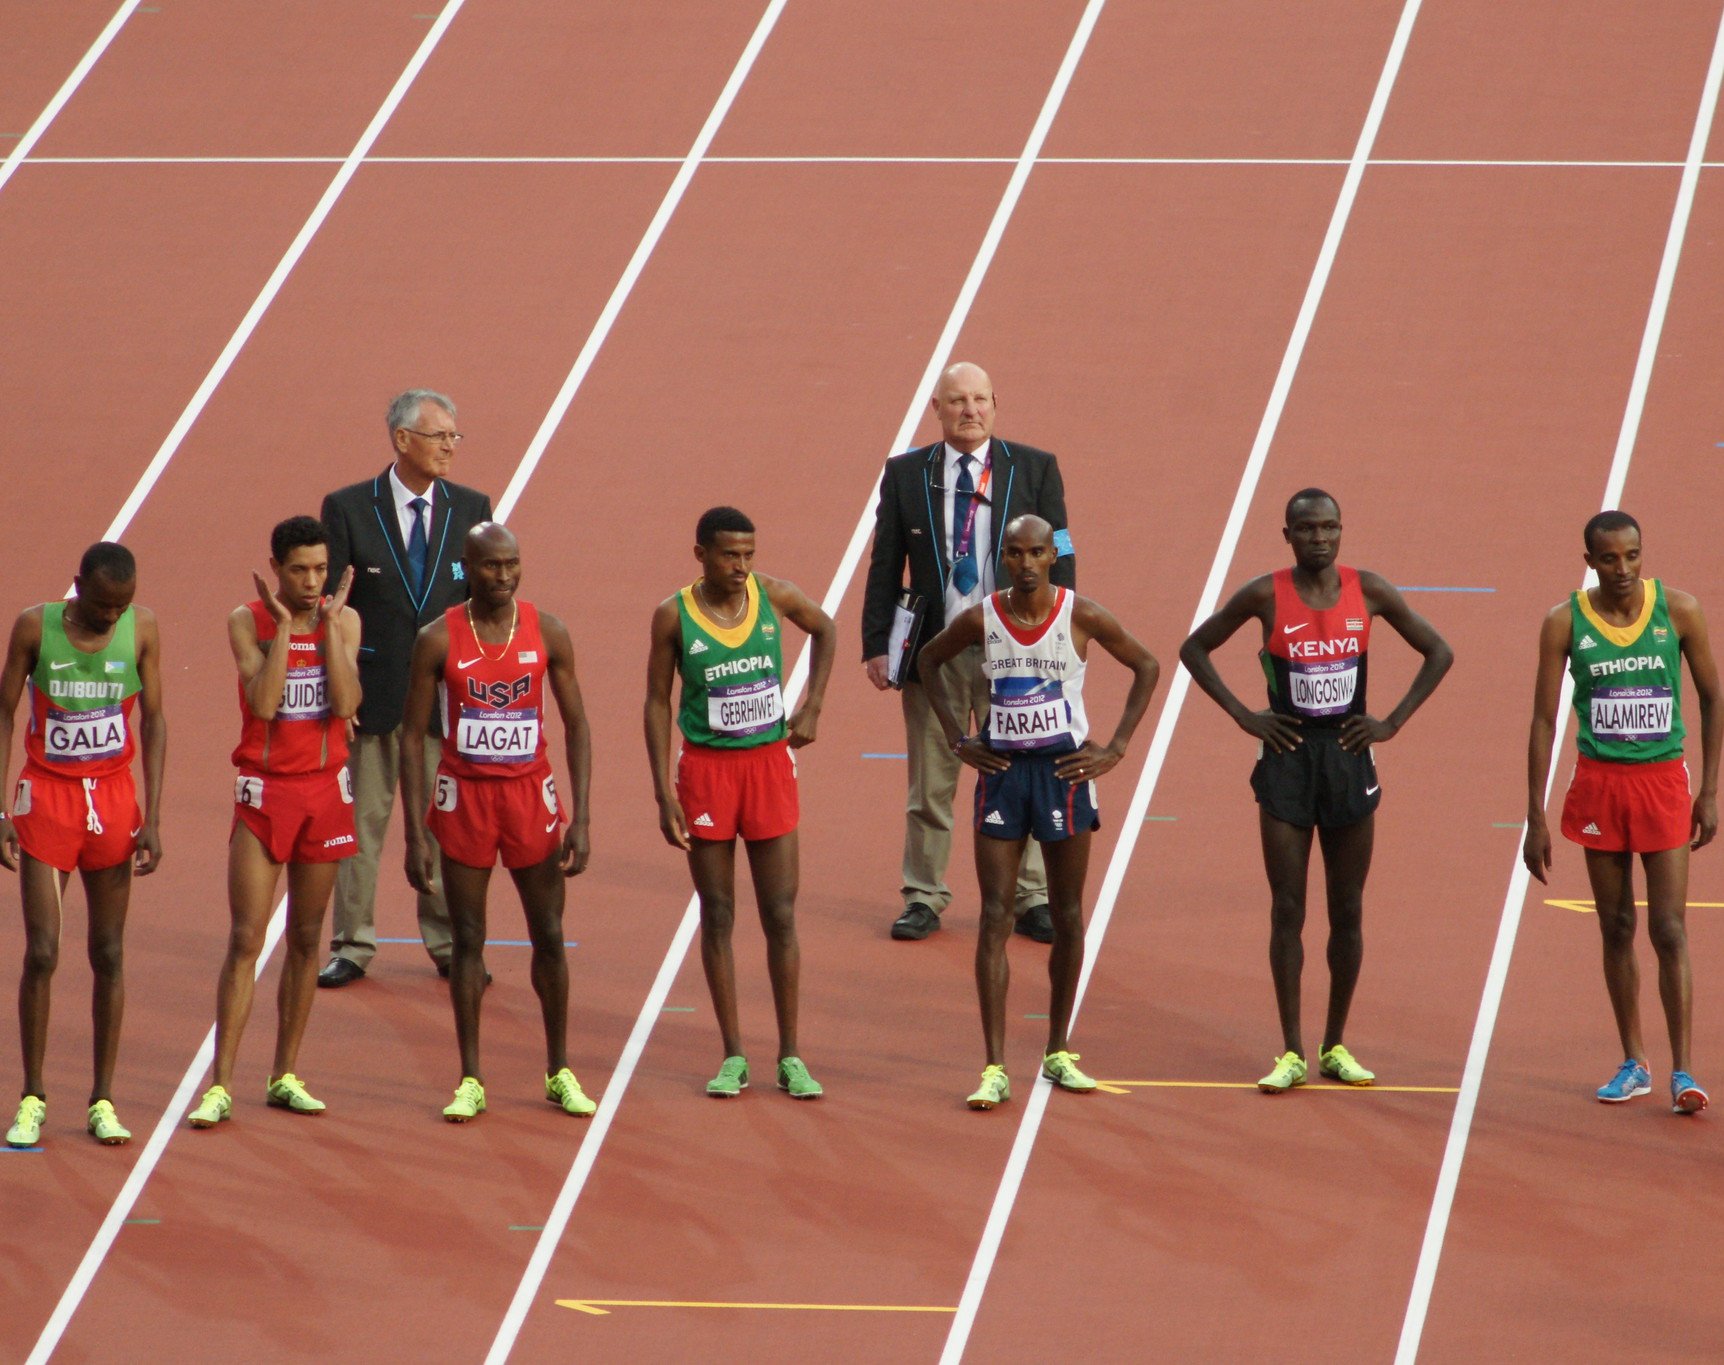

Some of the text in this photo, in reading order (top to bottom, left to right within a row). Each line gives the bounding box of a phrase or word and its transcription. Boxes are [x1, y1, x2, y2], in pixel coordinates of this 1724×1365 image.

[1288, 637, 1359, 658] KENYA
[287, 669, 306, 677] ndon
[704, 655, 774, 681] ETHIOPIA
[991, 657, 1067, 671] GREAT BRITAIN
[1304, 662, 1345, 673] London 2012
[1589, 655, 1665, 677] ETHIOPIA
[50, 680, 124, 699] DJIBOUTI
[467, 672, 532, 710] USA
[726, 681, 768, 696] London 2012
[1295, 674, 1353, 705] LONGOSIWA
[1609, 688, 1653, 697] London 2012
[720, 693, 775, 726] GEBRHIWET
[1003, 694, 1046, 706] London 2012
[63, 709, 106, 721] London 2012
[479, 710, 522, 719] London 2012
[996, 707, 1059, 735] FARAH
[1595, 703, 1669, 730] ALAMIREW
[50, 722, 122, 751] GALA
[465, 725, 532, 750] LAGAT
[241, 779, 252, 804] 6
[437, 779, 449, 807] 5
